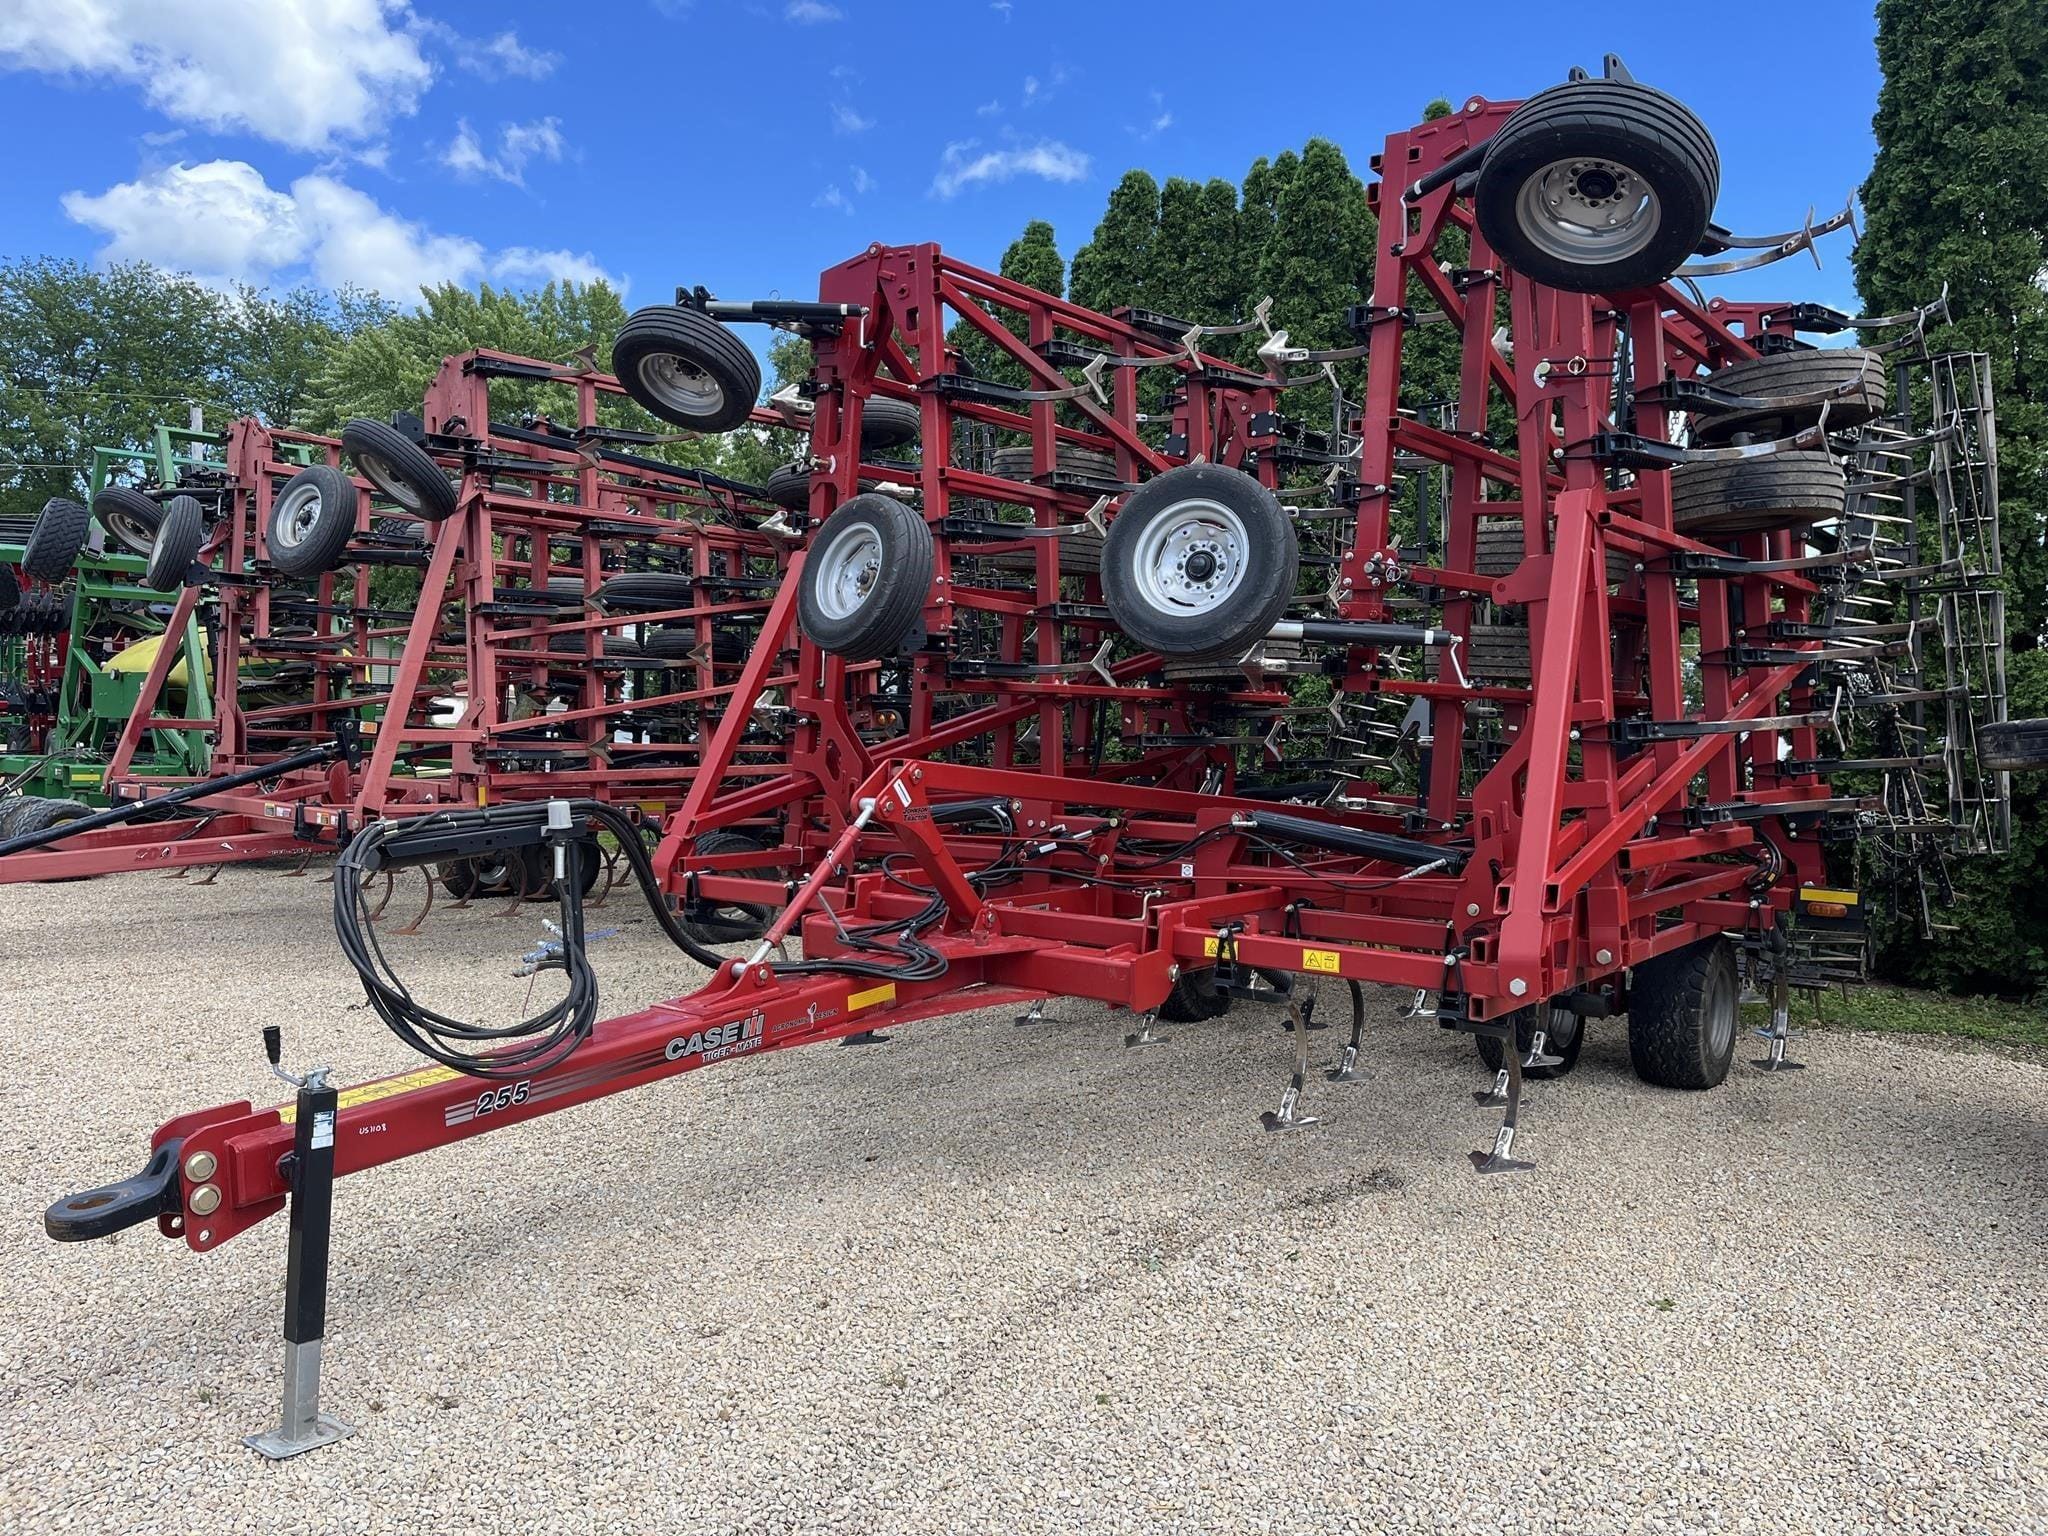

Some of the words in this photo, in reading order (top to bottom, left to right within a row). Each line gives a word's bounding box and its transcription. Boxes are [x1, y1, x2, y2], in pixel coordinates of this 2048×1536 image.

[665, 1021, 739, 1060] CASE
[701, 1037, 763, 1064] TIGER-MATE
[475, 1080, 531, 1118] 255
